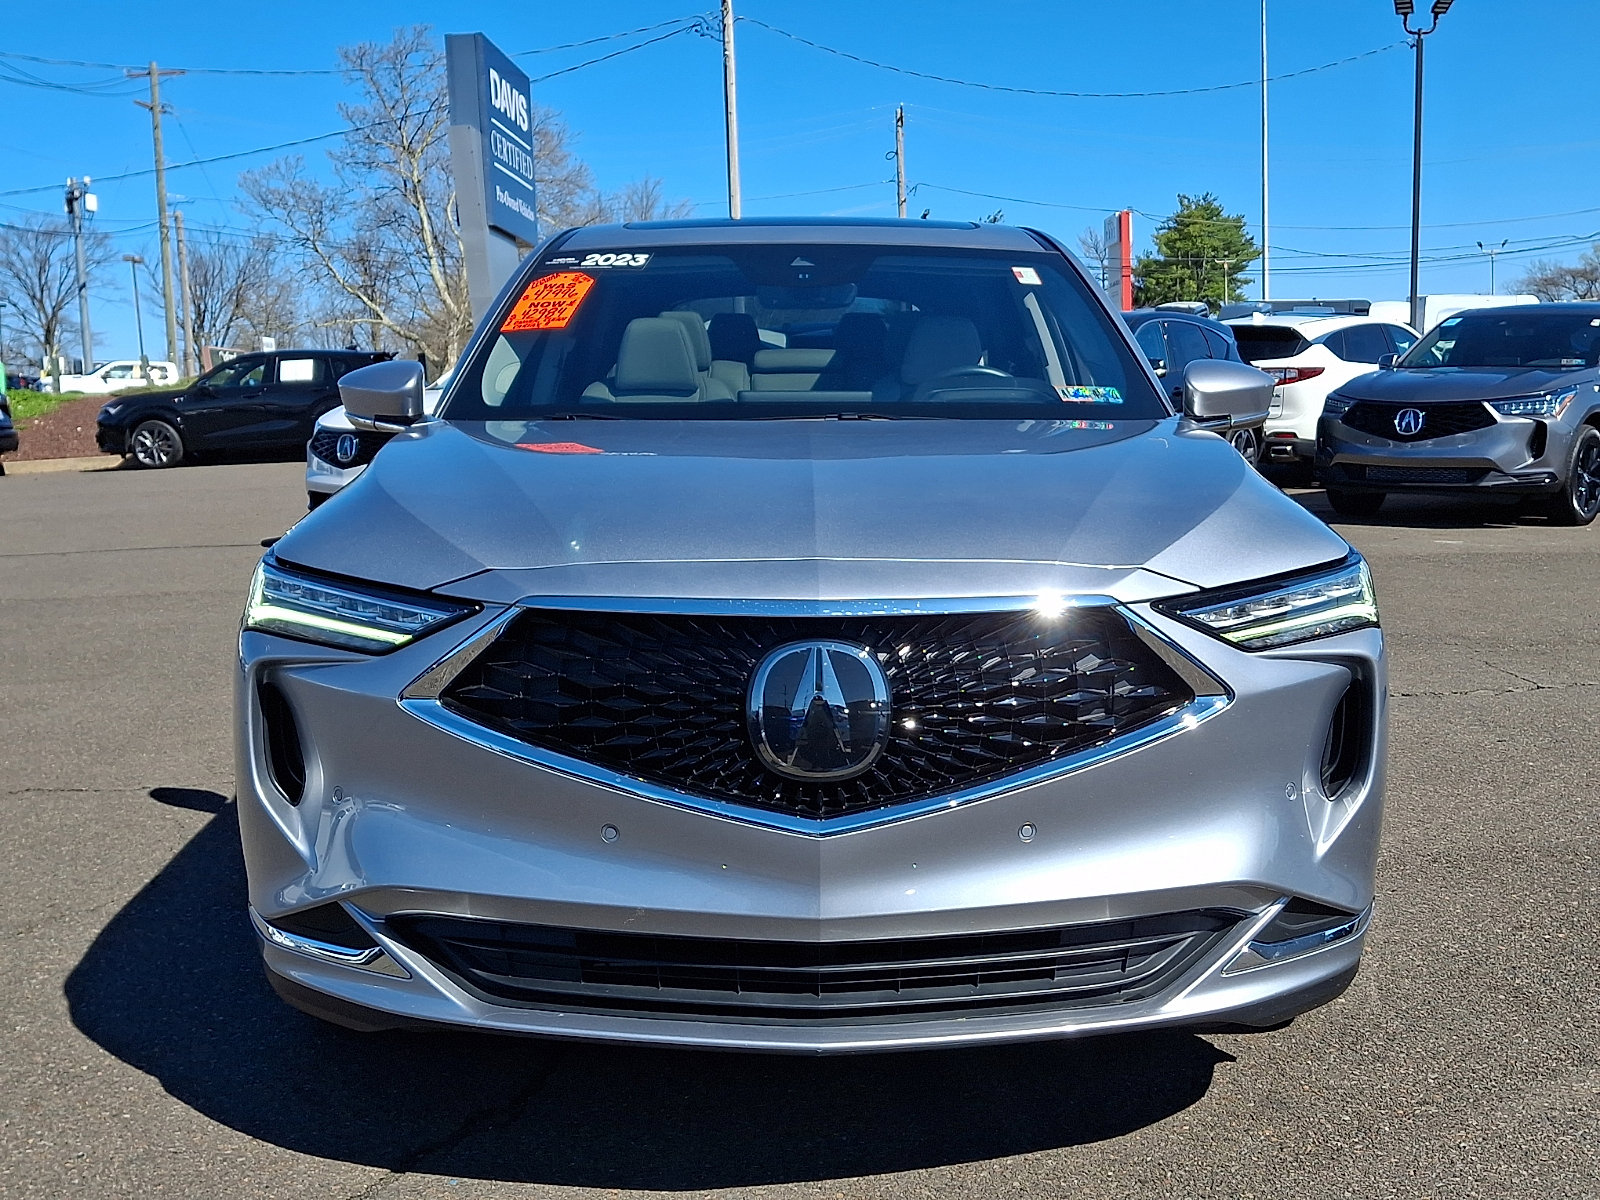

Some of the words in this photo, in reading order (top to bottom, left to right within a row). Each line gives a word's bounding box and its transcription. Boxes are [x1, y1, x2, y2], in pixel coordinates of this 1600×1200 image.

[489, 68, 528, 131] DAVIS
[490, 130, 533, 179] CERTIFIED
[580, 253, 649, 266] 2023
[528, 300, 566, 308] NOW
